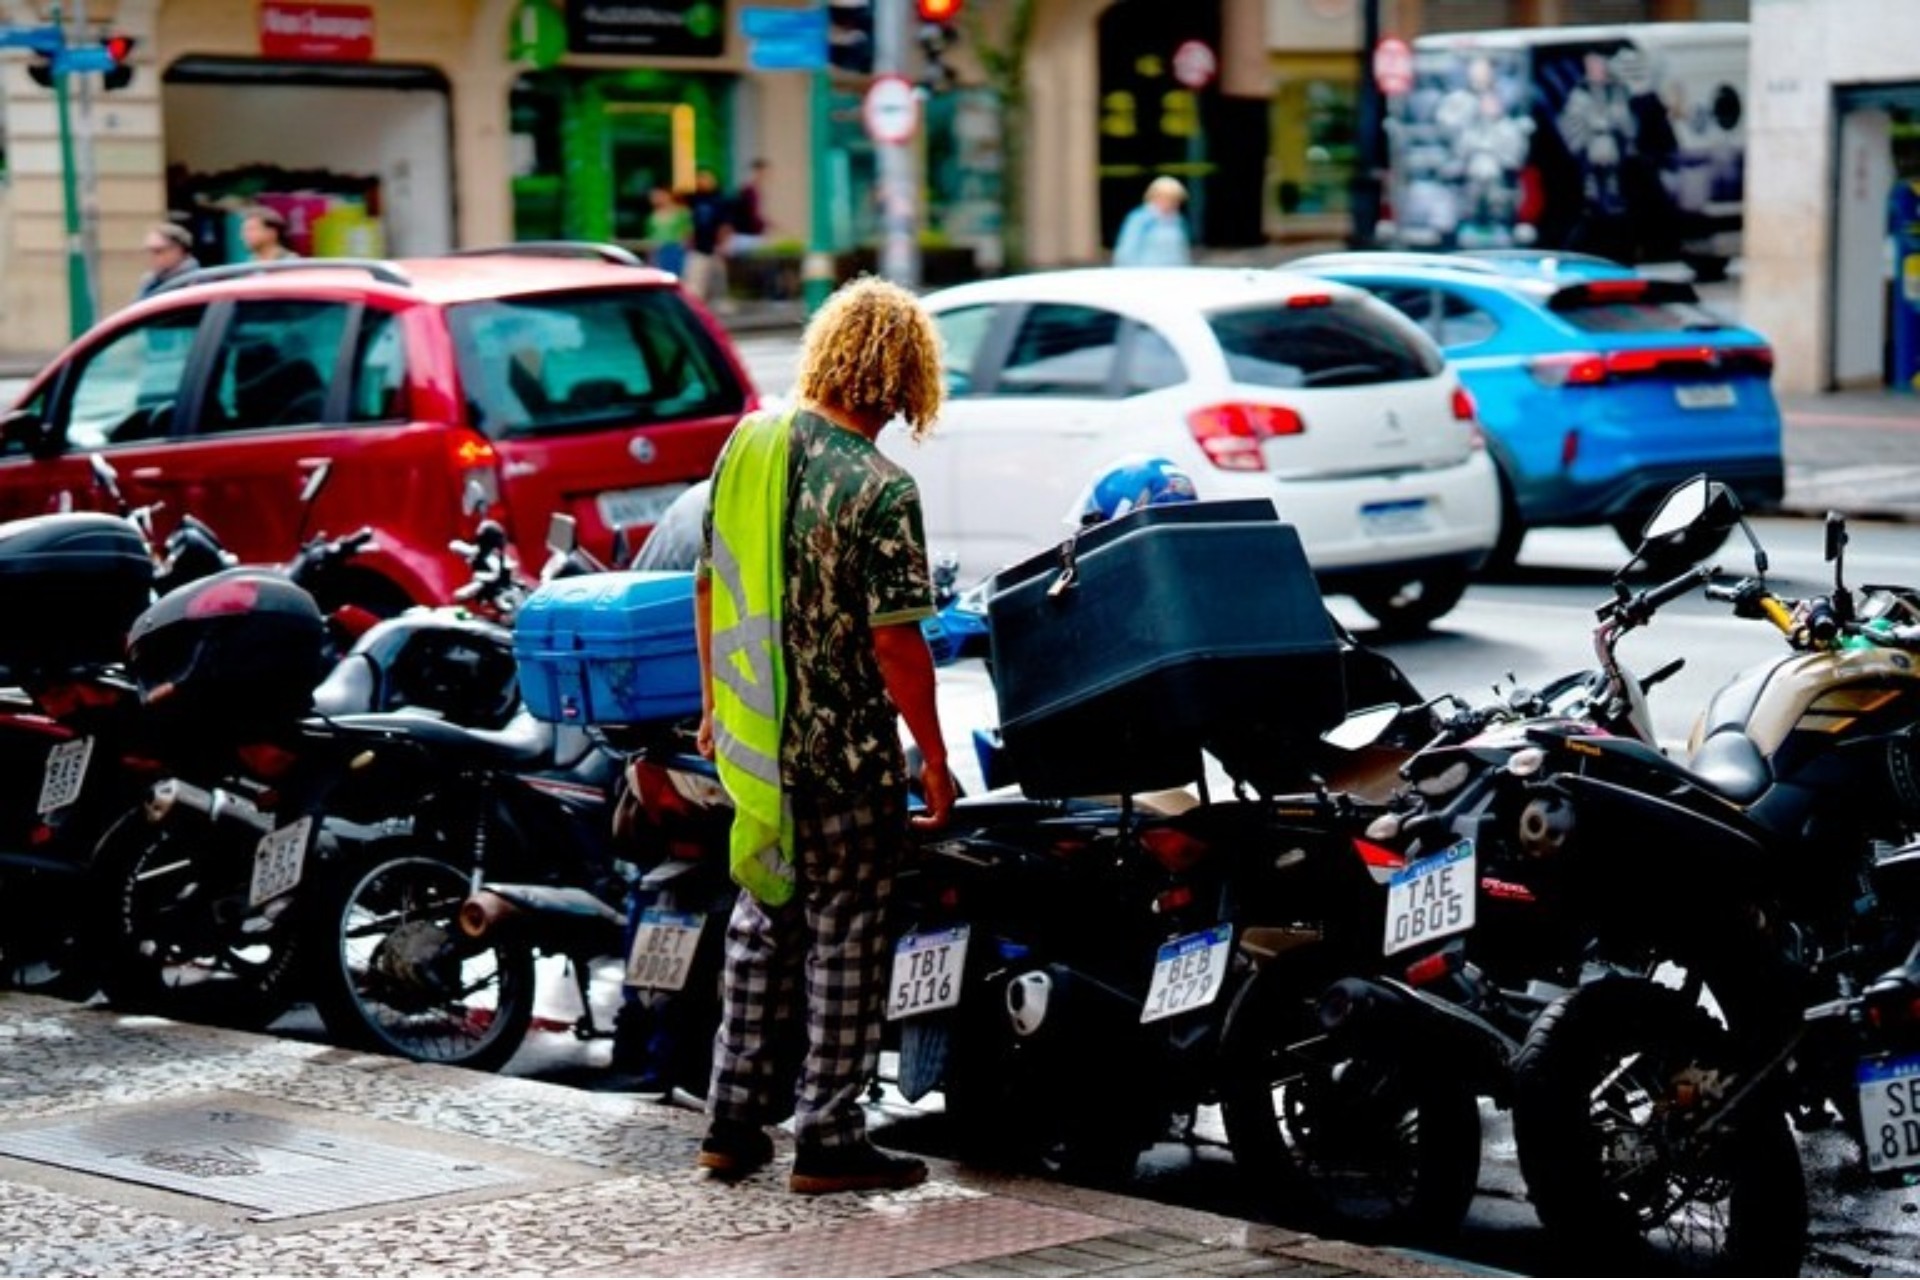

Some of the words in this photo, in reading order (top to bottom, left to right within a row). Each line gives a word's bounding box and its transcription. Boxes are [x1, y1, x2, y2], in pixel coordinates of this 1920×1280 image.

[1408, 866, 1454, 908] TAE
[909, 944, 951, 981] TBT
[897, 972, 952, 1011] 5I16
